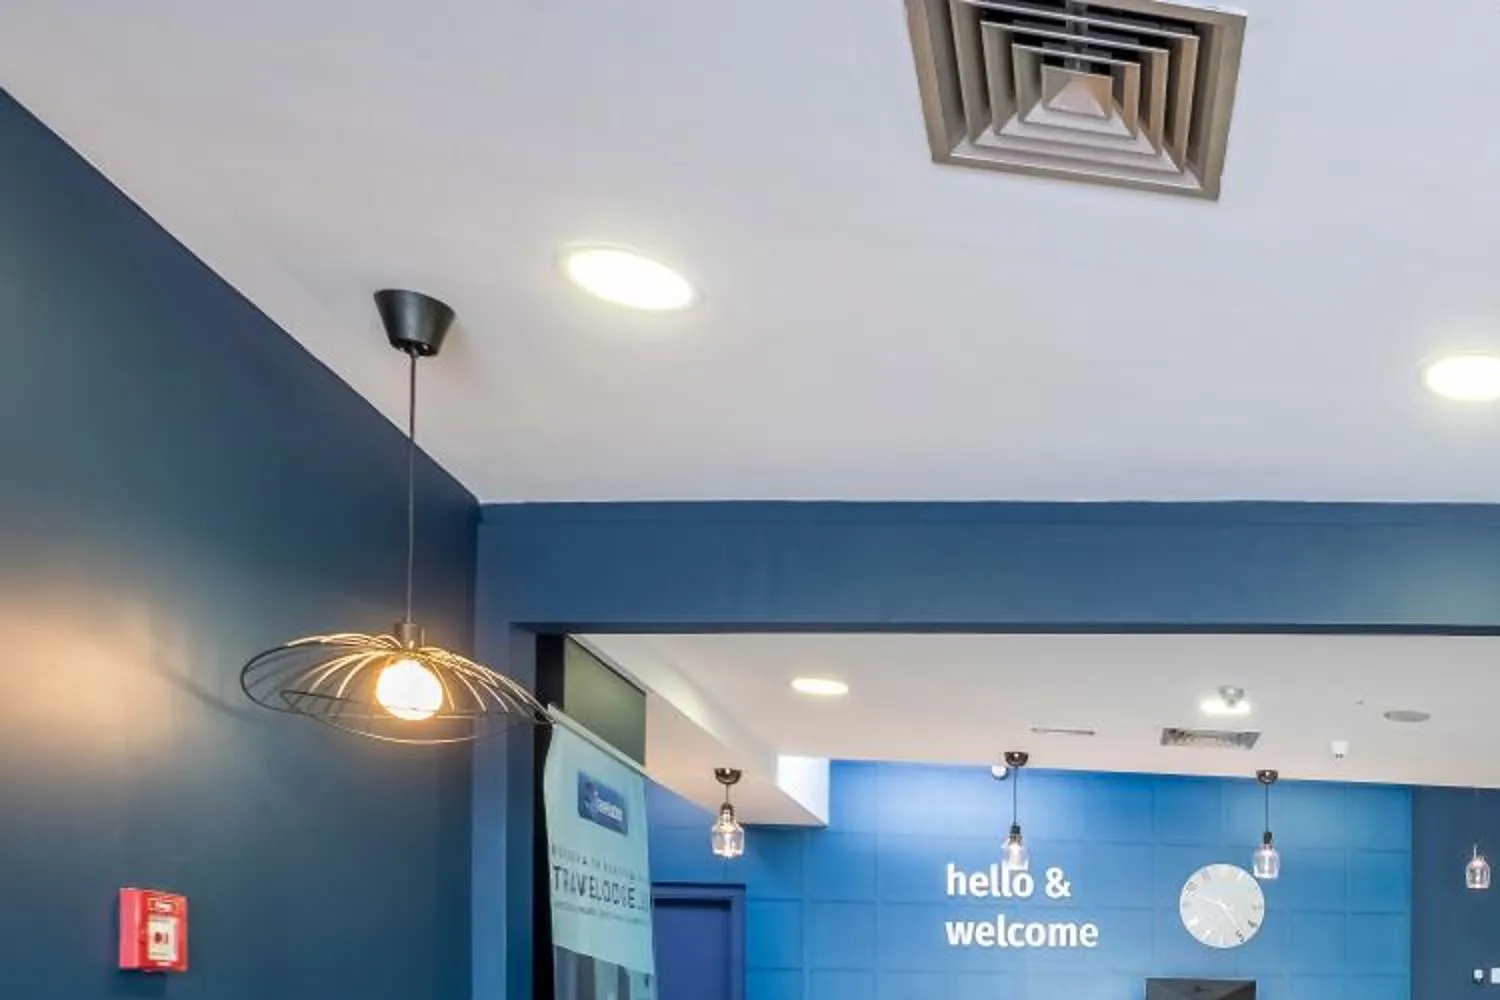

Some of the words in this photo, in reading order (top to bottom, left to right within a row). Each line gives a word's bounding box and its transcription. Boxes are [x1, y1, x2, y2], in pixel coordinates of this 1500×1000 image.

[946, 863, 1034, 897] hello
[1045, 867, 1071, 898] &
[945, 914, 1099, 947] welcome
